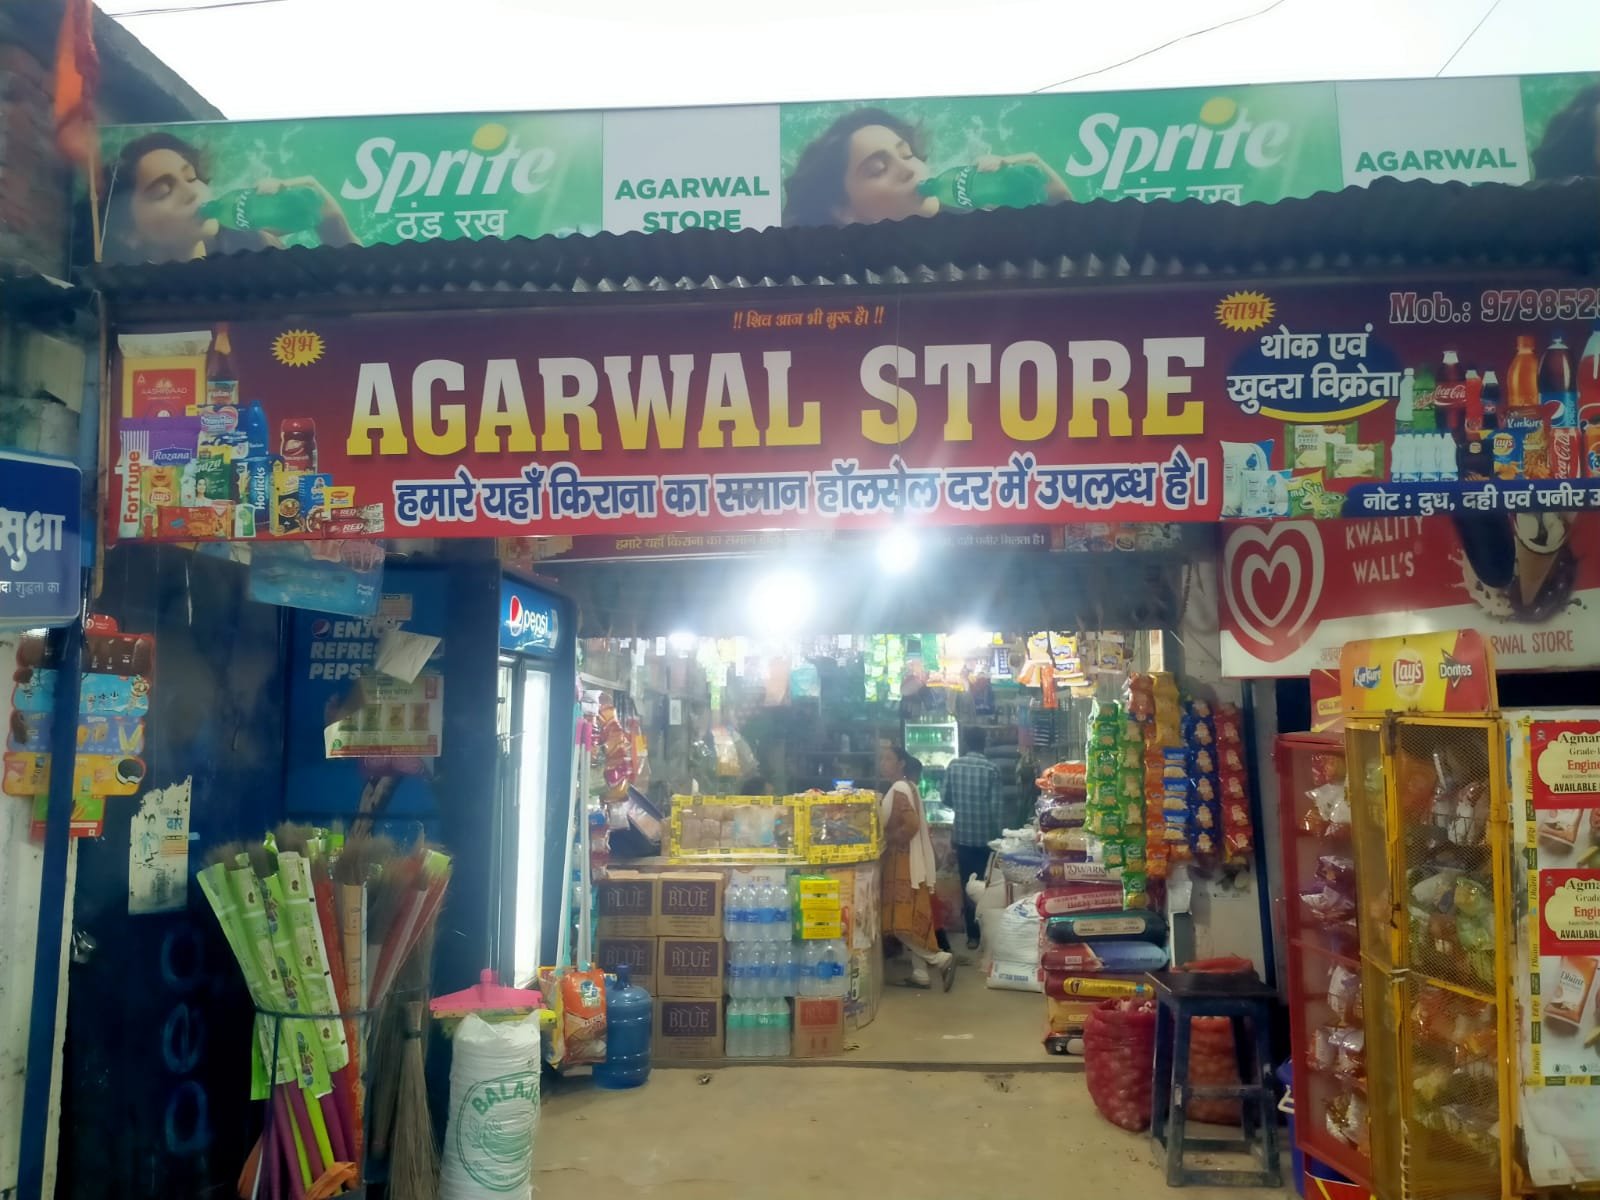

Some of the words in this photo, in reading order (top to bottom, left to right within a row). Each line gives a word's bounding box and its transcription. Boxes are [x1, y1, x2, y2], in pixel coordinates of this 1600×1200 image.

[1066, 97, 1289, 190] Sprite
[341, 124, 558, 213] Sprite
[1355, 148, 1517, 173] AGARWAL
[615, 176, 770, 200] AGARWAL
[395, 202, 443, 238] ठंड
[455, 210, 508, 238] रख
[642, 210, 742, 232] STORE
[1481, 288, 1600, 322] 979852
[281, 335, 316, 361] शुभ
[1260, 324, 1321, 361] थोक
[1328, 322, 1374, 359] एवं
[347, 351, 821, 456] AGARWAL
[860, 337, 1205, 445] STORE
[1226, 372, 1303, 414] खुदरा
[1311, 363, 1401, 403] विक्रेता
[154, 450, 190, 462] Rozana
[124, 450, 141, 524] Fortune
[256, 466, 265, 511] Horlicks
[394, 466, 477, 525] हमारे
[480, 465, 547, 523] यहाँ
[549, 462, 658, 520] किराना
[663, 473, 709, 517] का
[715, 471, 808, 515] समान
[815, 455, 940, 517] हॉलसेल
[944, 463, 995, 511] दर
[996, 452, 1036, 509] में
[1036, 460, 1157, 508] उपलब्ध
[1462, 483, 1499, 510] दही
[1503, 483, 1534, 510] एवं
[1536, 482, 1586, 507] पनीर
[343, 522, 364, 533] RED
[1346, 516, 1423, 550] KWALITY
[1352, 551, 1414, 584] WALL'S
[47, 582, 60, 593] का
[523, 609, 548, 638] pepsi
[1532, 629, 1574, 653] STORE
[1440, 663, 1473, 679] Doritos
[1554, 782, 1597, 793] AVAILABLE
[669, 886, 710, 907] BLUE
[671, 946, 712, 968] BLUE
[670, 1006, 711, 1028] BLUE
